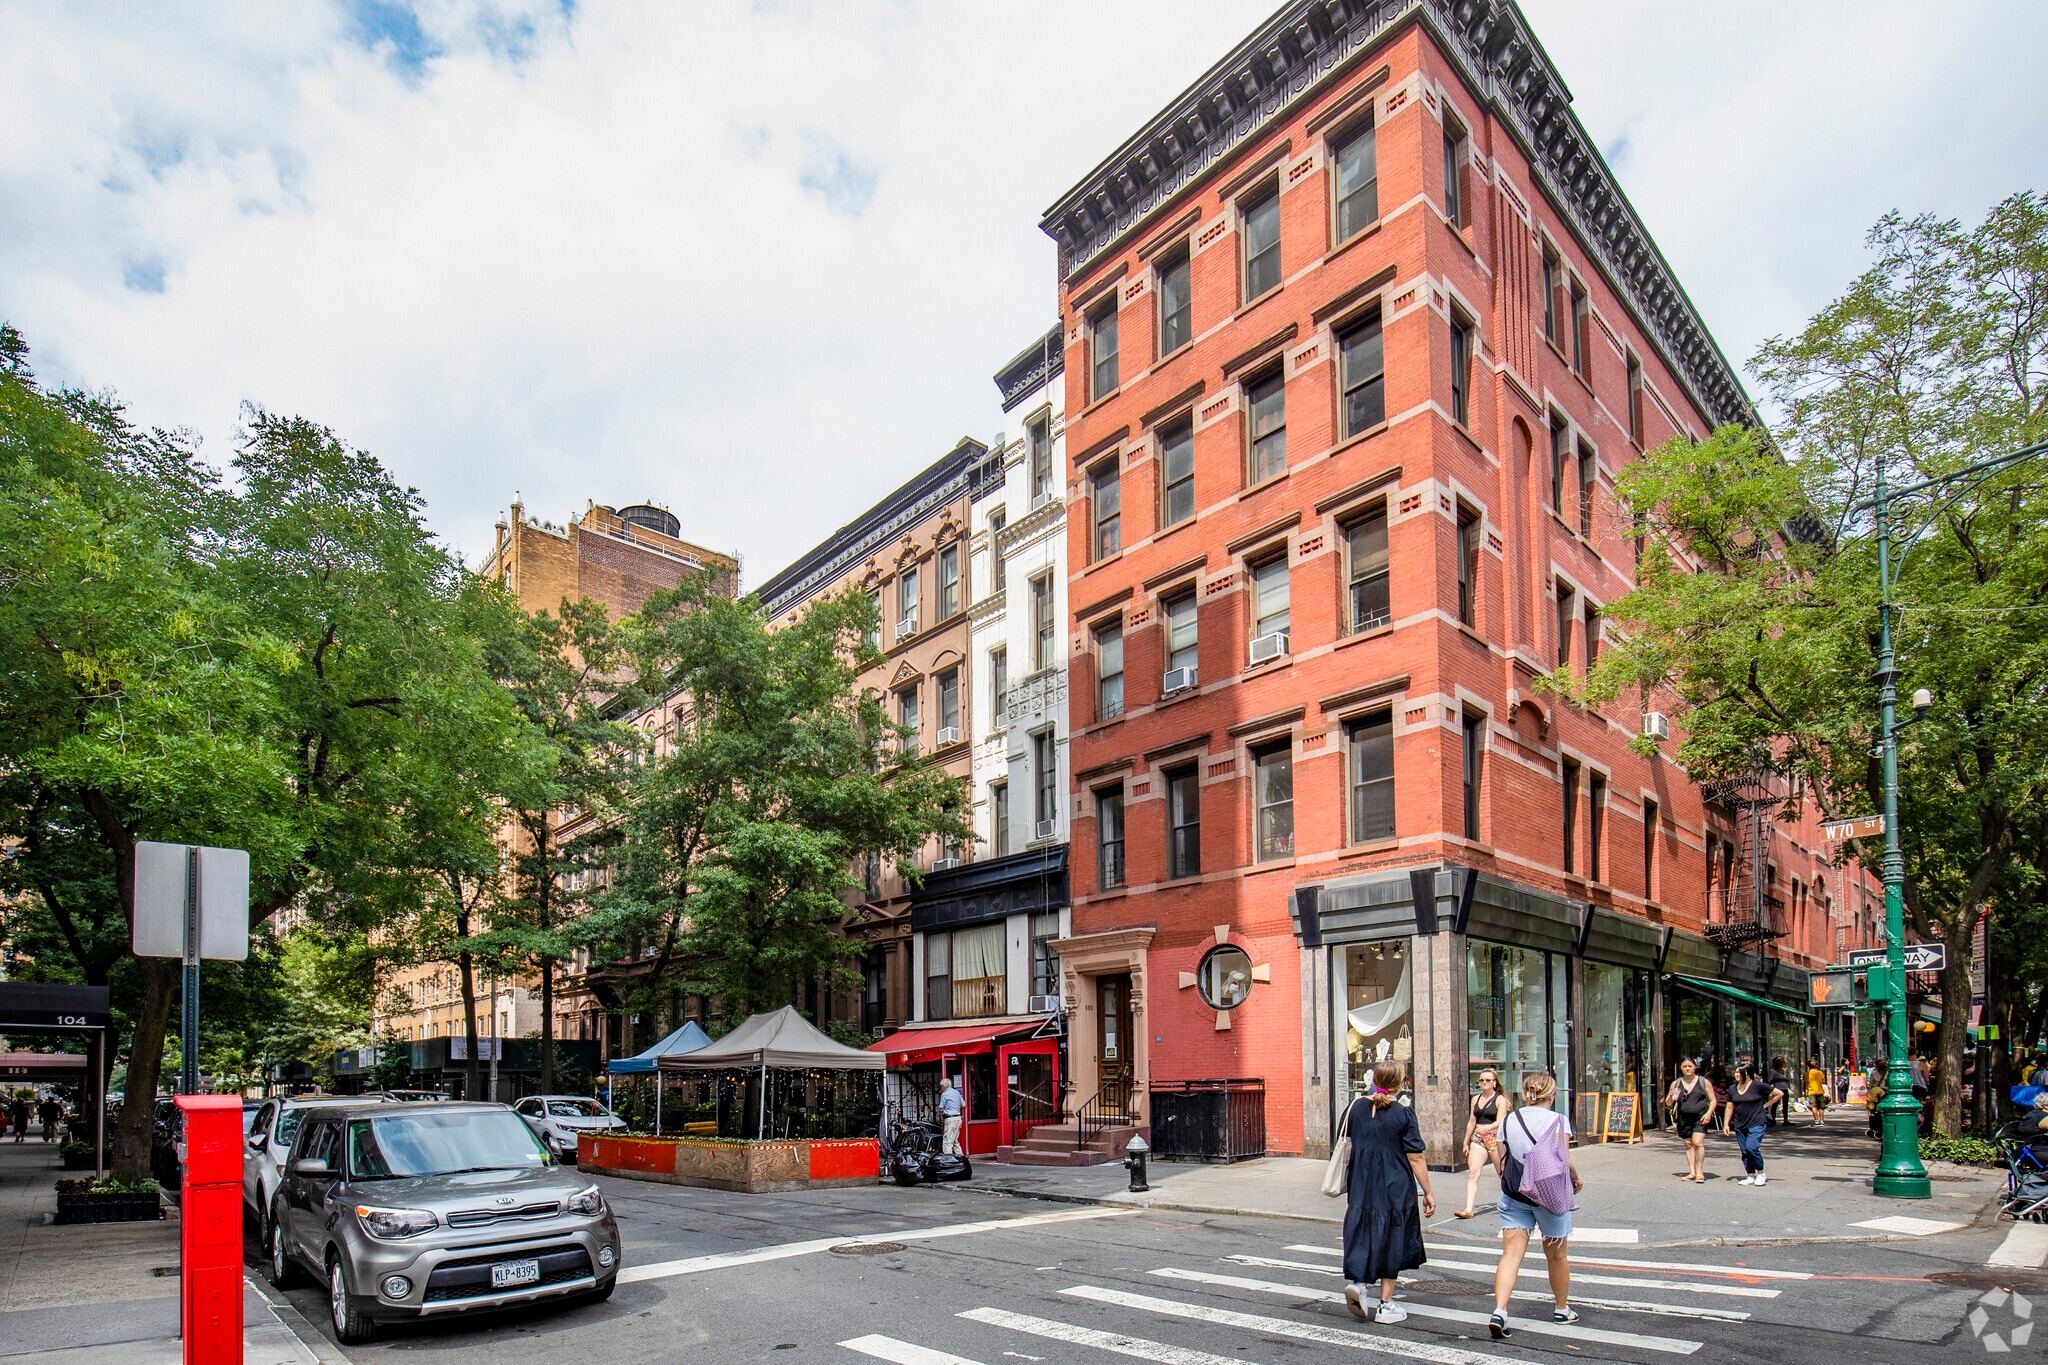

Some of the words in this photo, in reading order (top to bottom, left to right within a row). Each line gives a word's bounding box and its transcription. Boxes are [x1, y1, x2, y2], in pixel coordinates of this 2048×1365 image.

[1825, 825, 1836, 840] W
[1836, 823, 1854, 838] 70
[1864, 819, 1877, 829] ST
[57, 1015, 87, 1025] 104
[1011, 1056, 1019, 1066] a
